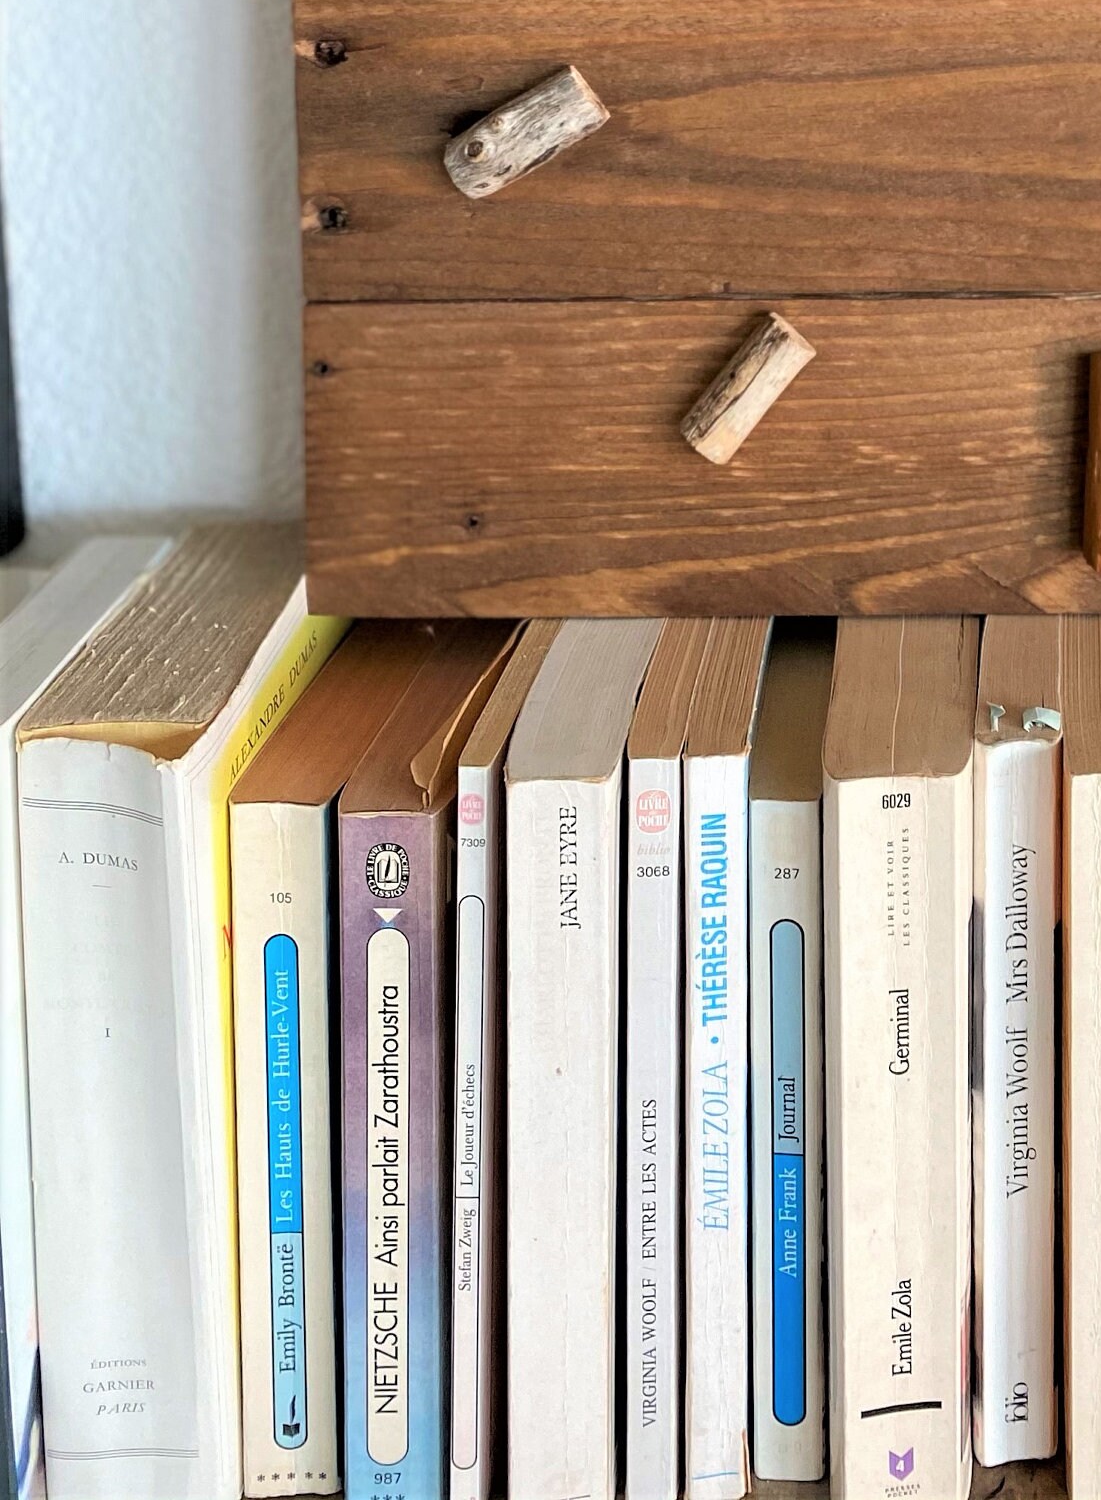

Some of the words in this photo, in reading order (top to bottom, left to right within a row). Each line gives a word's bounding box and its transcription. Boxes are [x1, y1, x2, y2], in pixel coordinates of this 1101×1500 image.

[229, 684, 285, 785] ALEXANDRE
[289, 630, 318, 688] DUMAS
[882, 793, 911, 809] 6029
[59, 852, 74, 864] A.
[83, 853, 138, 871] DUMAS
[460, 838, 486, 847] 7309
[560, 806, 577, 865] EYRE
[700, 813, 728, 908] RAQUIN
[269, 892, 292, 904] 105
[637, 866, 670, 877] 3068
[774, 868, 800, 880] 287
[887, 882, 894, 897] ET
[902, 827, 911, 916] CLASSIQUES
[1005, 844, 1036, 953] Dalloway
[560, 873, 581, 929] JANE
[887, 905, 895, 936] LIRE
[695, 915, 728, 1027] THÉRÈSE
[1005, 959, 1028, 1005] Mrs
[270, 970, 290, 1078] Hurle-Vent
[888, 988, 910, 1076] Germinal
[371, 985, 399, 1128] Zarathoustra
[1005, 1026, 1028, 1099] Woolf
[271, 1089, 290, 1111] de
[461, 1063, 476, 1119] d'échecs
[701, 1060, 728, 1135] ZOLA
[777, 1076, 799, 1143] Journal
[273, 1122, 292, 1185] Hauts
[460, 1123, 478, 1169] Joueur
[642, 1100, 656, 1155] ACTES
[1006, 1103, 1037, 1199] Virginia
[371, 1137, 405, 1206] parlait
[460, 1169, 474, 1186] Le
[642, 1163, 656, 1194] LES
[697, 1142, 729, 1230] ÉMILE
[778, 1167, 797, 1223] Frank
[275, 1190, 293, 1223] Les
[459, 1208, 476, 1247] Zweig
[642, 1201, 656, 1259] ENTRE
[373, 1215, 399, 1267] Ainsi
[778, 1228, 797, 1278] Anne
[276, 1243, 295, 1308] Brontë
[458, 1253, 472, 1291] Stefan
[891, 1279, 912, 1319] Zola
[642, 1278, 656, 1341] WOOLF
[277, 1319, 302, 1373] Emily
[373, 1282, 399, 1414] NIETZSCHE
[891, 1322, 912, 1377] Emile
[83, 1380, 155, 1393] GARNIER
[96, 1402, 146, 1416] PARIS
[642, 1347, 656, 1427] VIRGINIA
[1005, 1382, 1028, 1424] folio
[374, 1472, 401, 1485] 987
